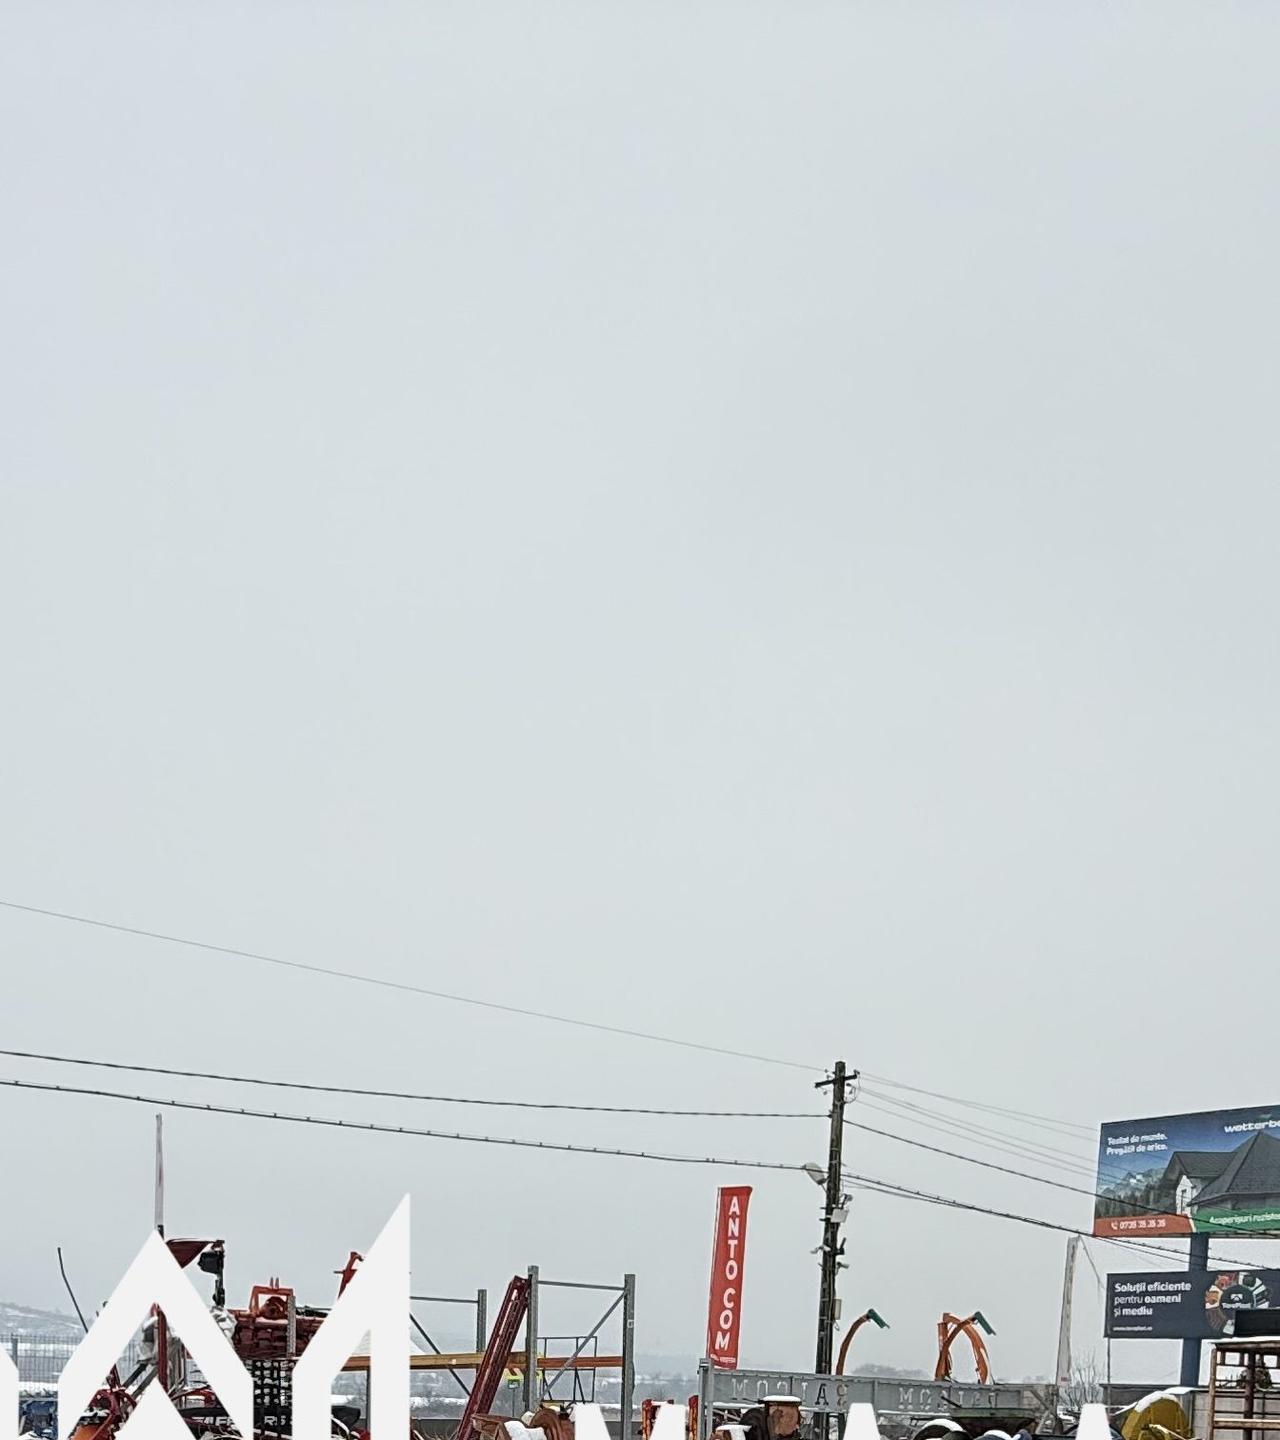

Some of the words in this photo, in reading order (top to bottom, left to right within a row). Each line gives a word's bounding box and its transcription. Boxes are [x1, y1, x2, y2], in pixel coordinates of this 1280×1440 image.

[725, 1196, 741, 1281] ANTO
[1147, 1281, 1192, 1292] eficiente
[1114, 1296, 1143, 1306] pentru
[1144, 1293, 1182, 1303] oameni
[1122, 1306, 1153, 1316] mediu
[715, 1288, 736, 1351] COM
